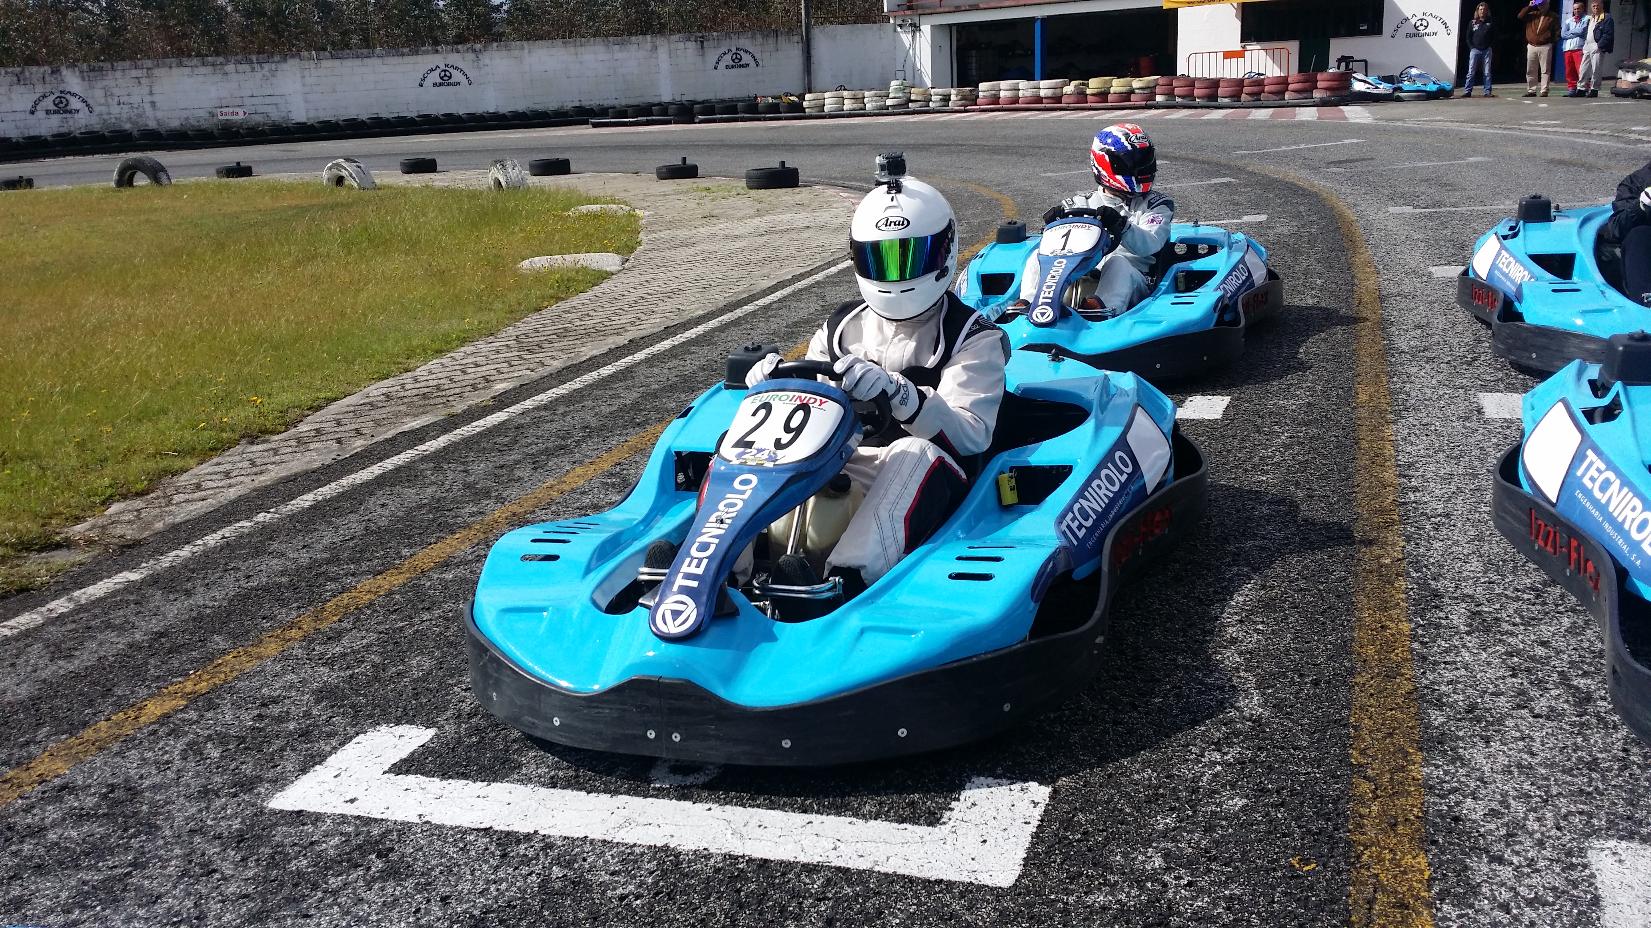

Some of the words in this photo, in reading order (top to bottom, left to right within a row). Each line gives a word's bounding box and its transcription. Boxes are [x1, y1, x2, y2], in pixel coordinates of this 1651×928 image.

[1391, 13, 1417, 38] ESCOLA
[1422, 11, 1451, 36] KARTING
[714, 48, 732, 70] ESCOLA
[735, 46, 760, 67] KARTING
[418, 64, 440, 87] ESCOLA
[444, 63, 472, 86] KARTING
[29, 90, 54, 115] ESCOLA
[59, 90, 93, 113] KARTING
[880, 217, 905, 228] Arai
[1060, 229, 1072, 251] 1
[1038, 258, 1067, 306] TECNIROLO
[751, 394, 829, 407] EUROINDY
[731, 401, 812, 451] 29
[1060, 450, 1134, 547] TECNIROLO
[1575, 489, 1604, 523] ENGENHARIA
[671, 473, 758, 592] TECNIROLO
